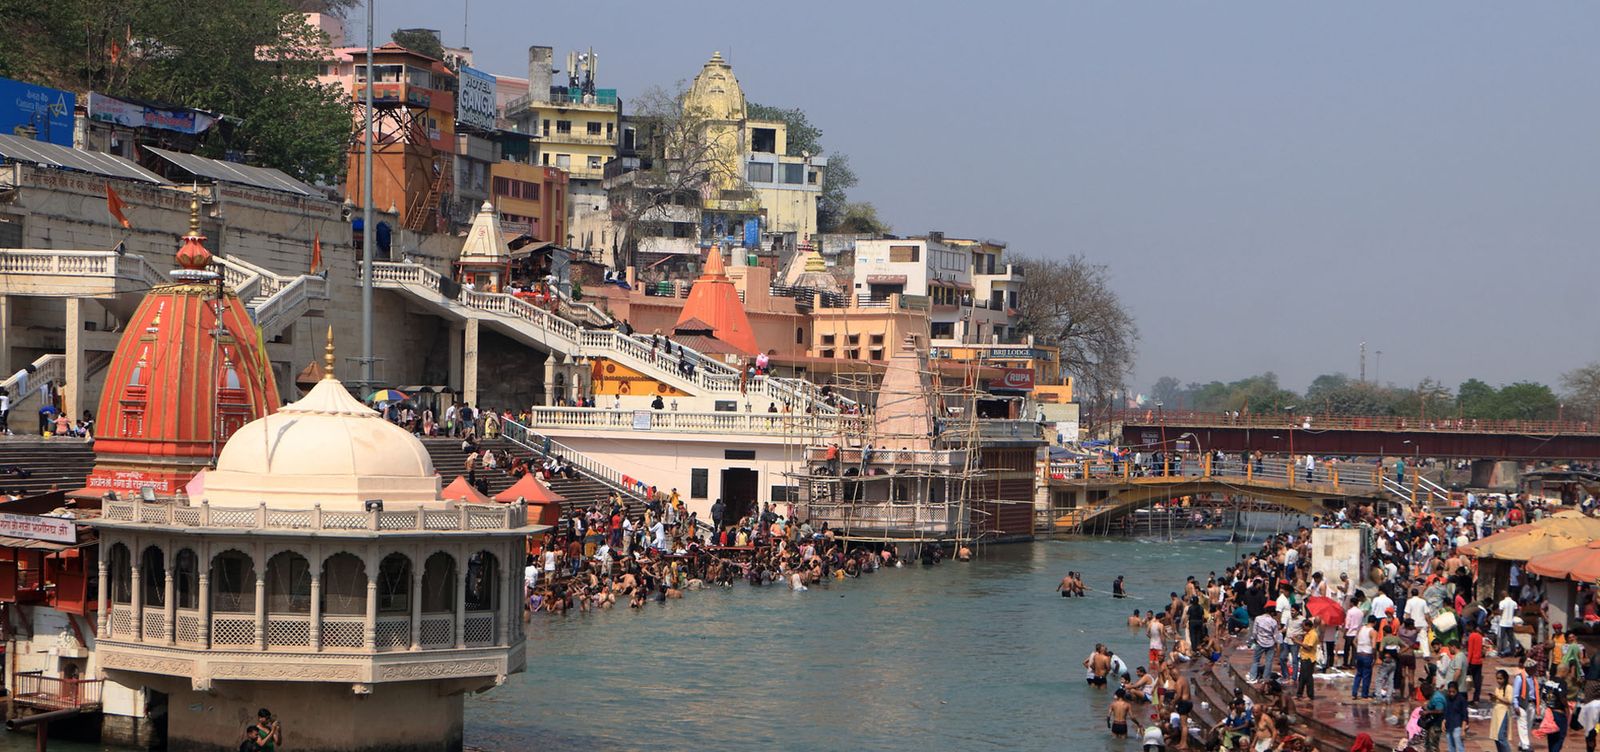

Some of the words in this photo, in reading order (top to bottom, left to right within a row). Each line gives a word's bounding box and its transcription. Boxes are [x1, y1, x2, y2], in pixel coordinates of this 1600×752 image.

[466, 78, 492, 95] HOTEL
[461, 87, 496, 119] GANGA
[1009, 373, 1031, 382] RUPA
[58, 523, 69, 536] जी
